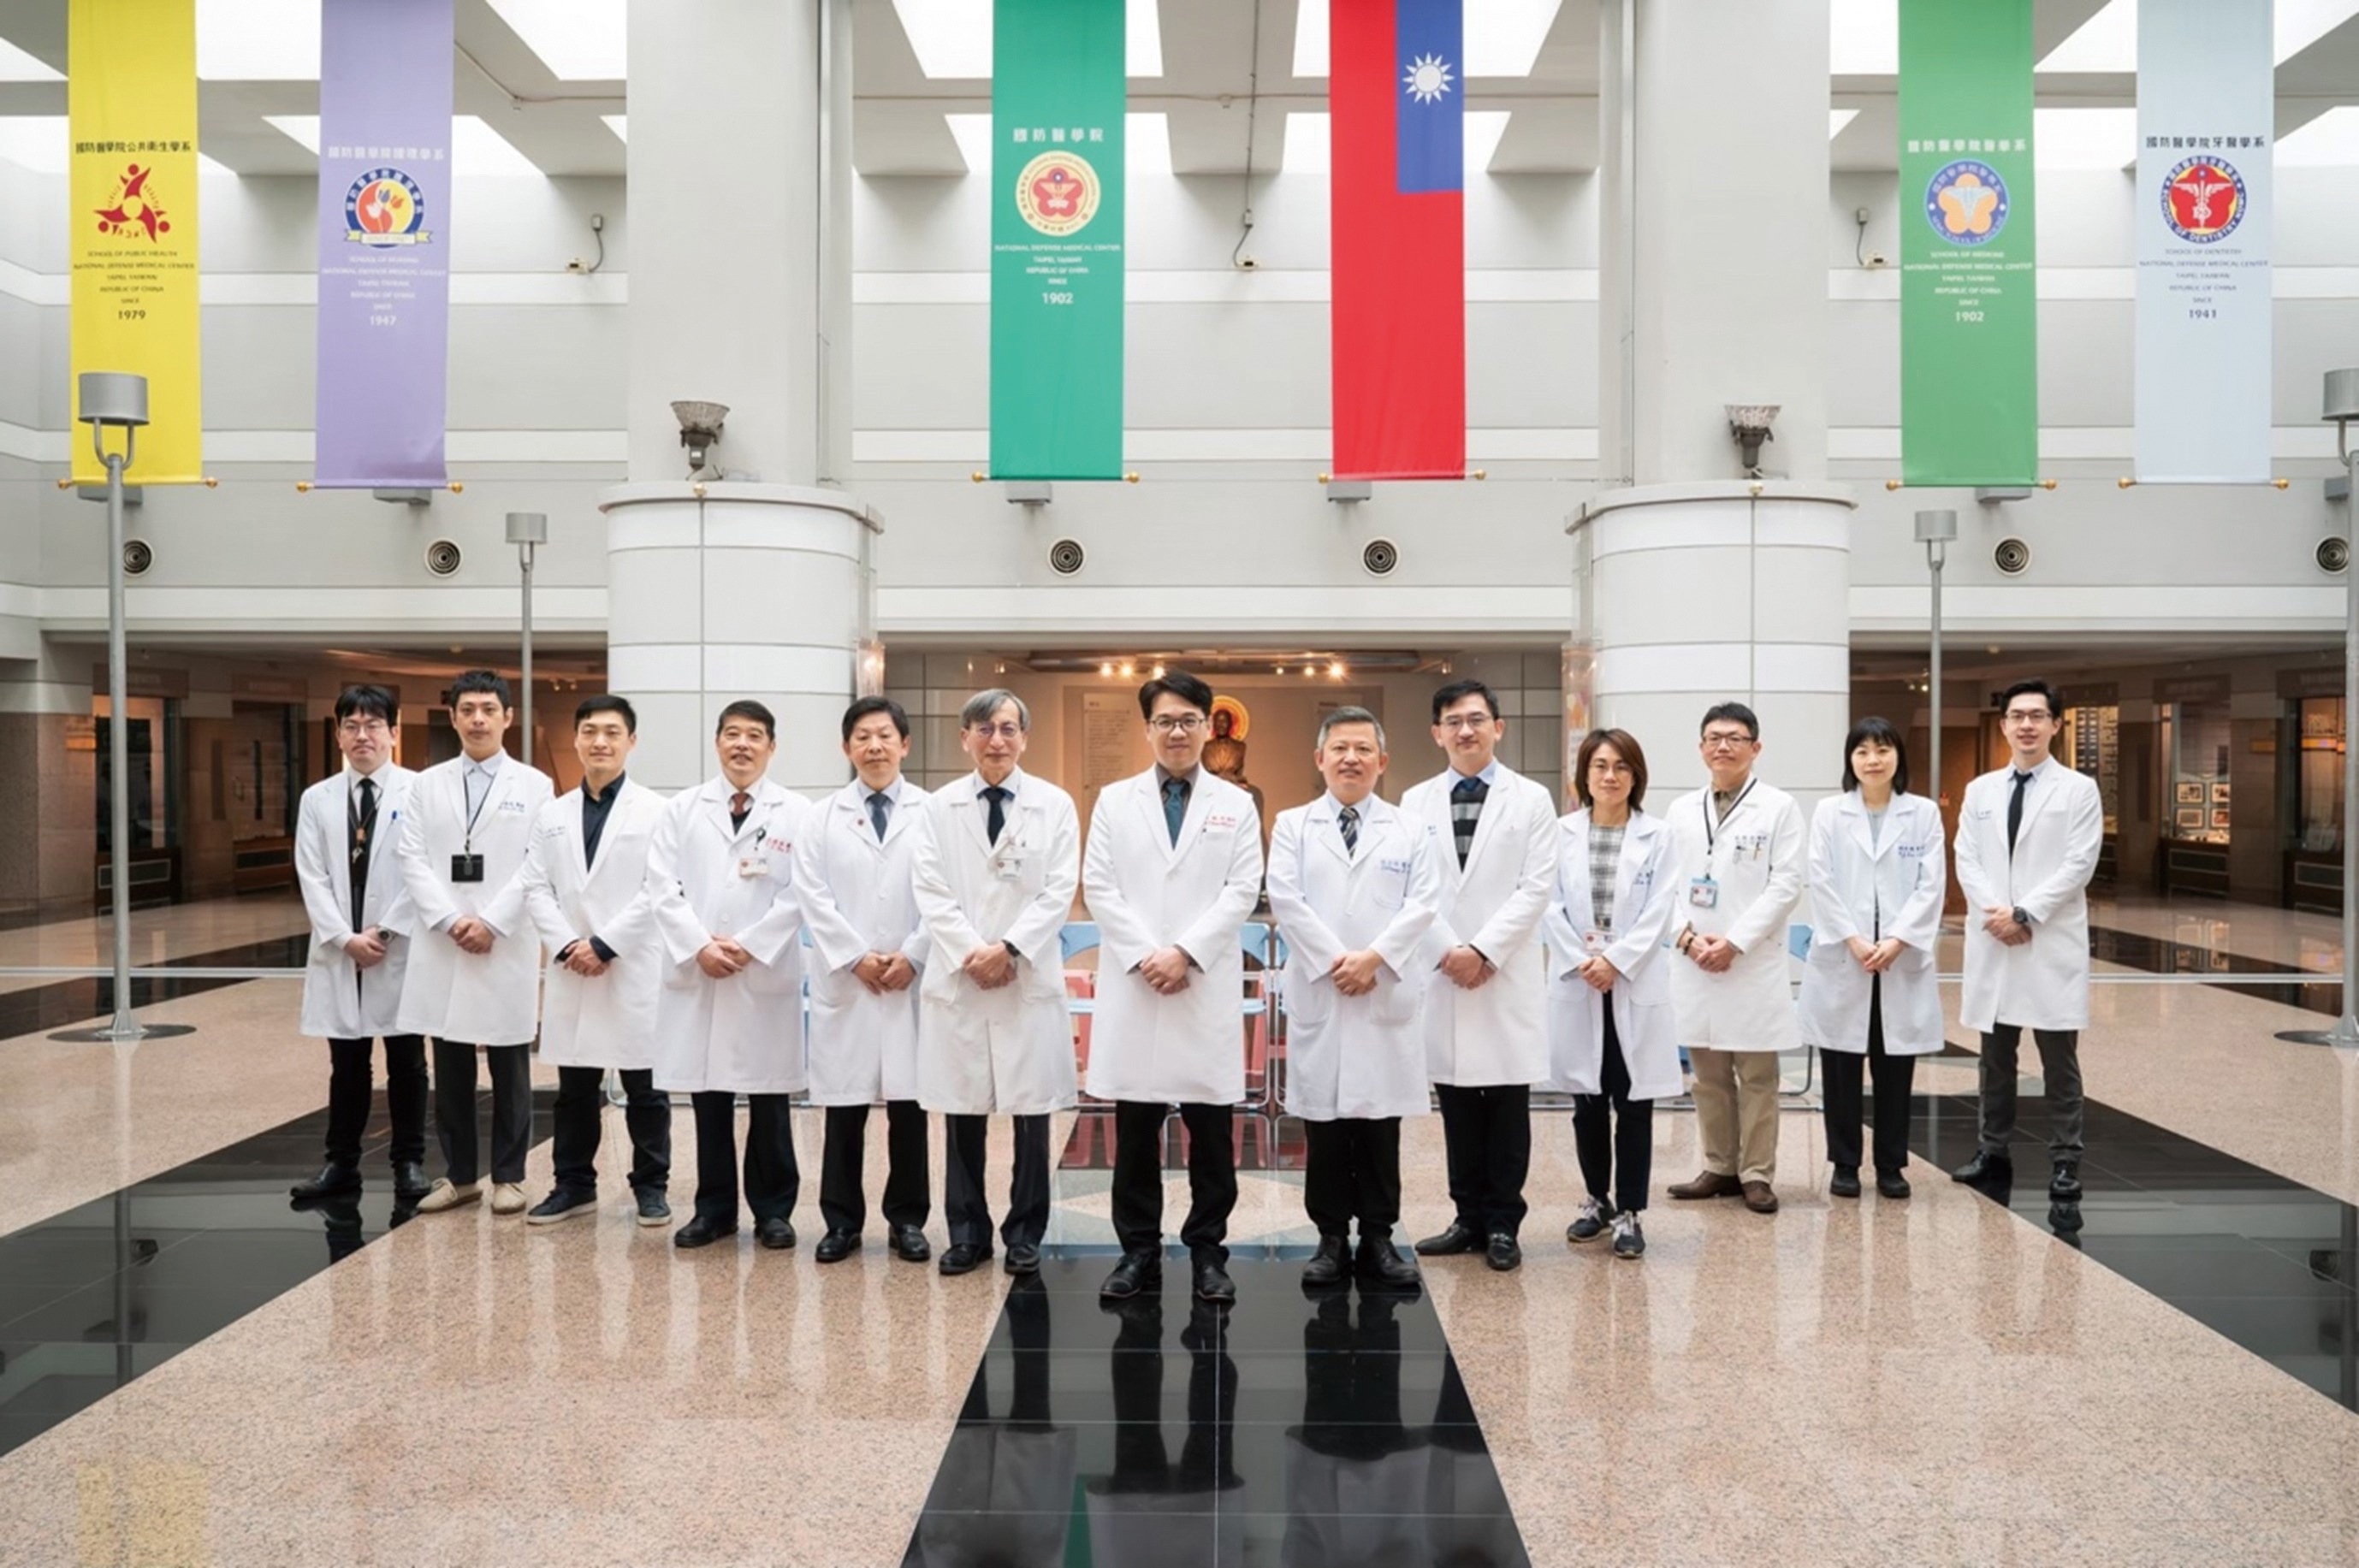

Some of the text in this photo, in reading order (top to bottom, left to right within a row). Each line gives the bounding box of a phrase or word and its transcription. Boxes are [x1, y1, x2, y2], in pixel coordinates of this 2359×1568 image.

[1013, 128, 1104, 142] 國防醫學院
[75, 141, 191, 153] 國防醫學院公共衛生學系
[2146, 136, 2265, 149] 國防醫學院牙醫學系
[1042, 292, 1074, 305] 1902
[118, 309, 146, 321] 1979
[1955, 311, 1985, 322] 1902
[2189, 309, 2217, 319] 1941
[370, 315, 397, 326] 1947
